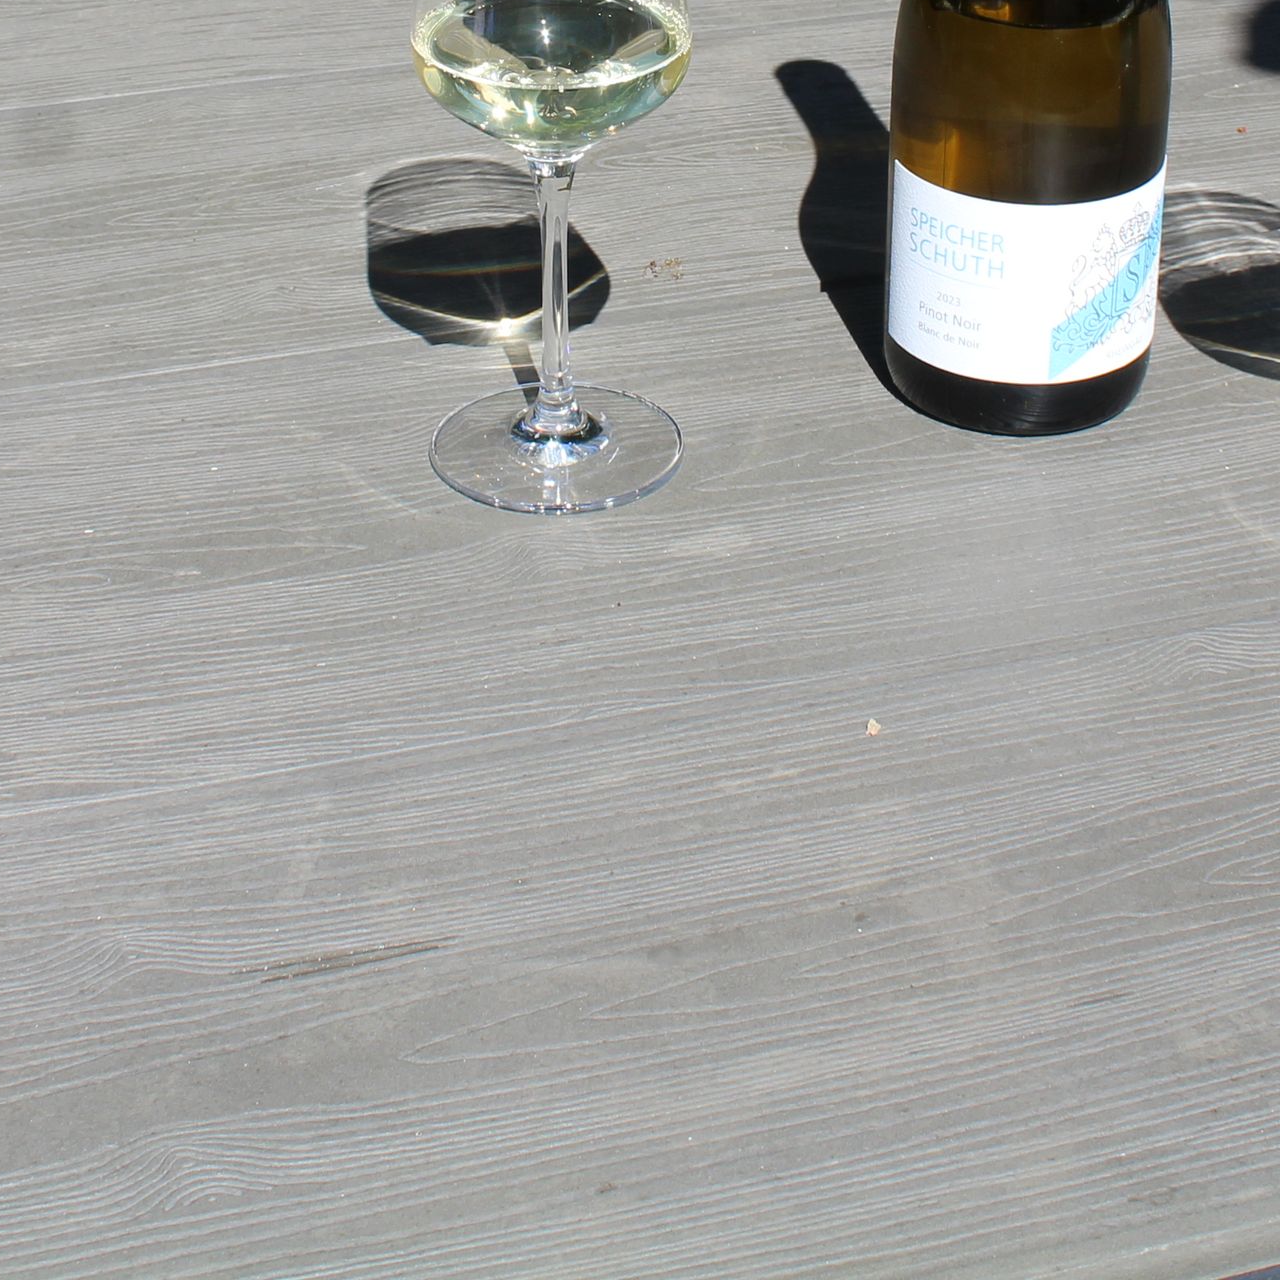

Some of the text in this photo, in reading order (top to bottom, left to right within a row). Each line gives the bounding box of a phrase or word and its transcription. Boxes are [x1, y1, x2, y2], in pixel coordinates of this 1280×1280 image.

[910, 207, 1005, 254] SPEICHER
[909, 231, 1005, 279] SCHUTH
[936, 291, 961, 307] 2023
[918, 300, 982, 332] Pinot Noir
[918, 321, 981, 350] Blanc de Noir
